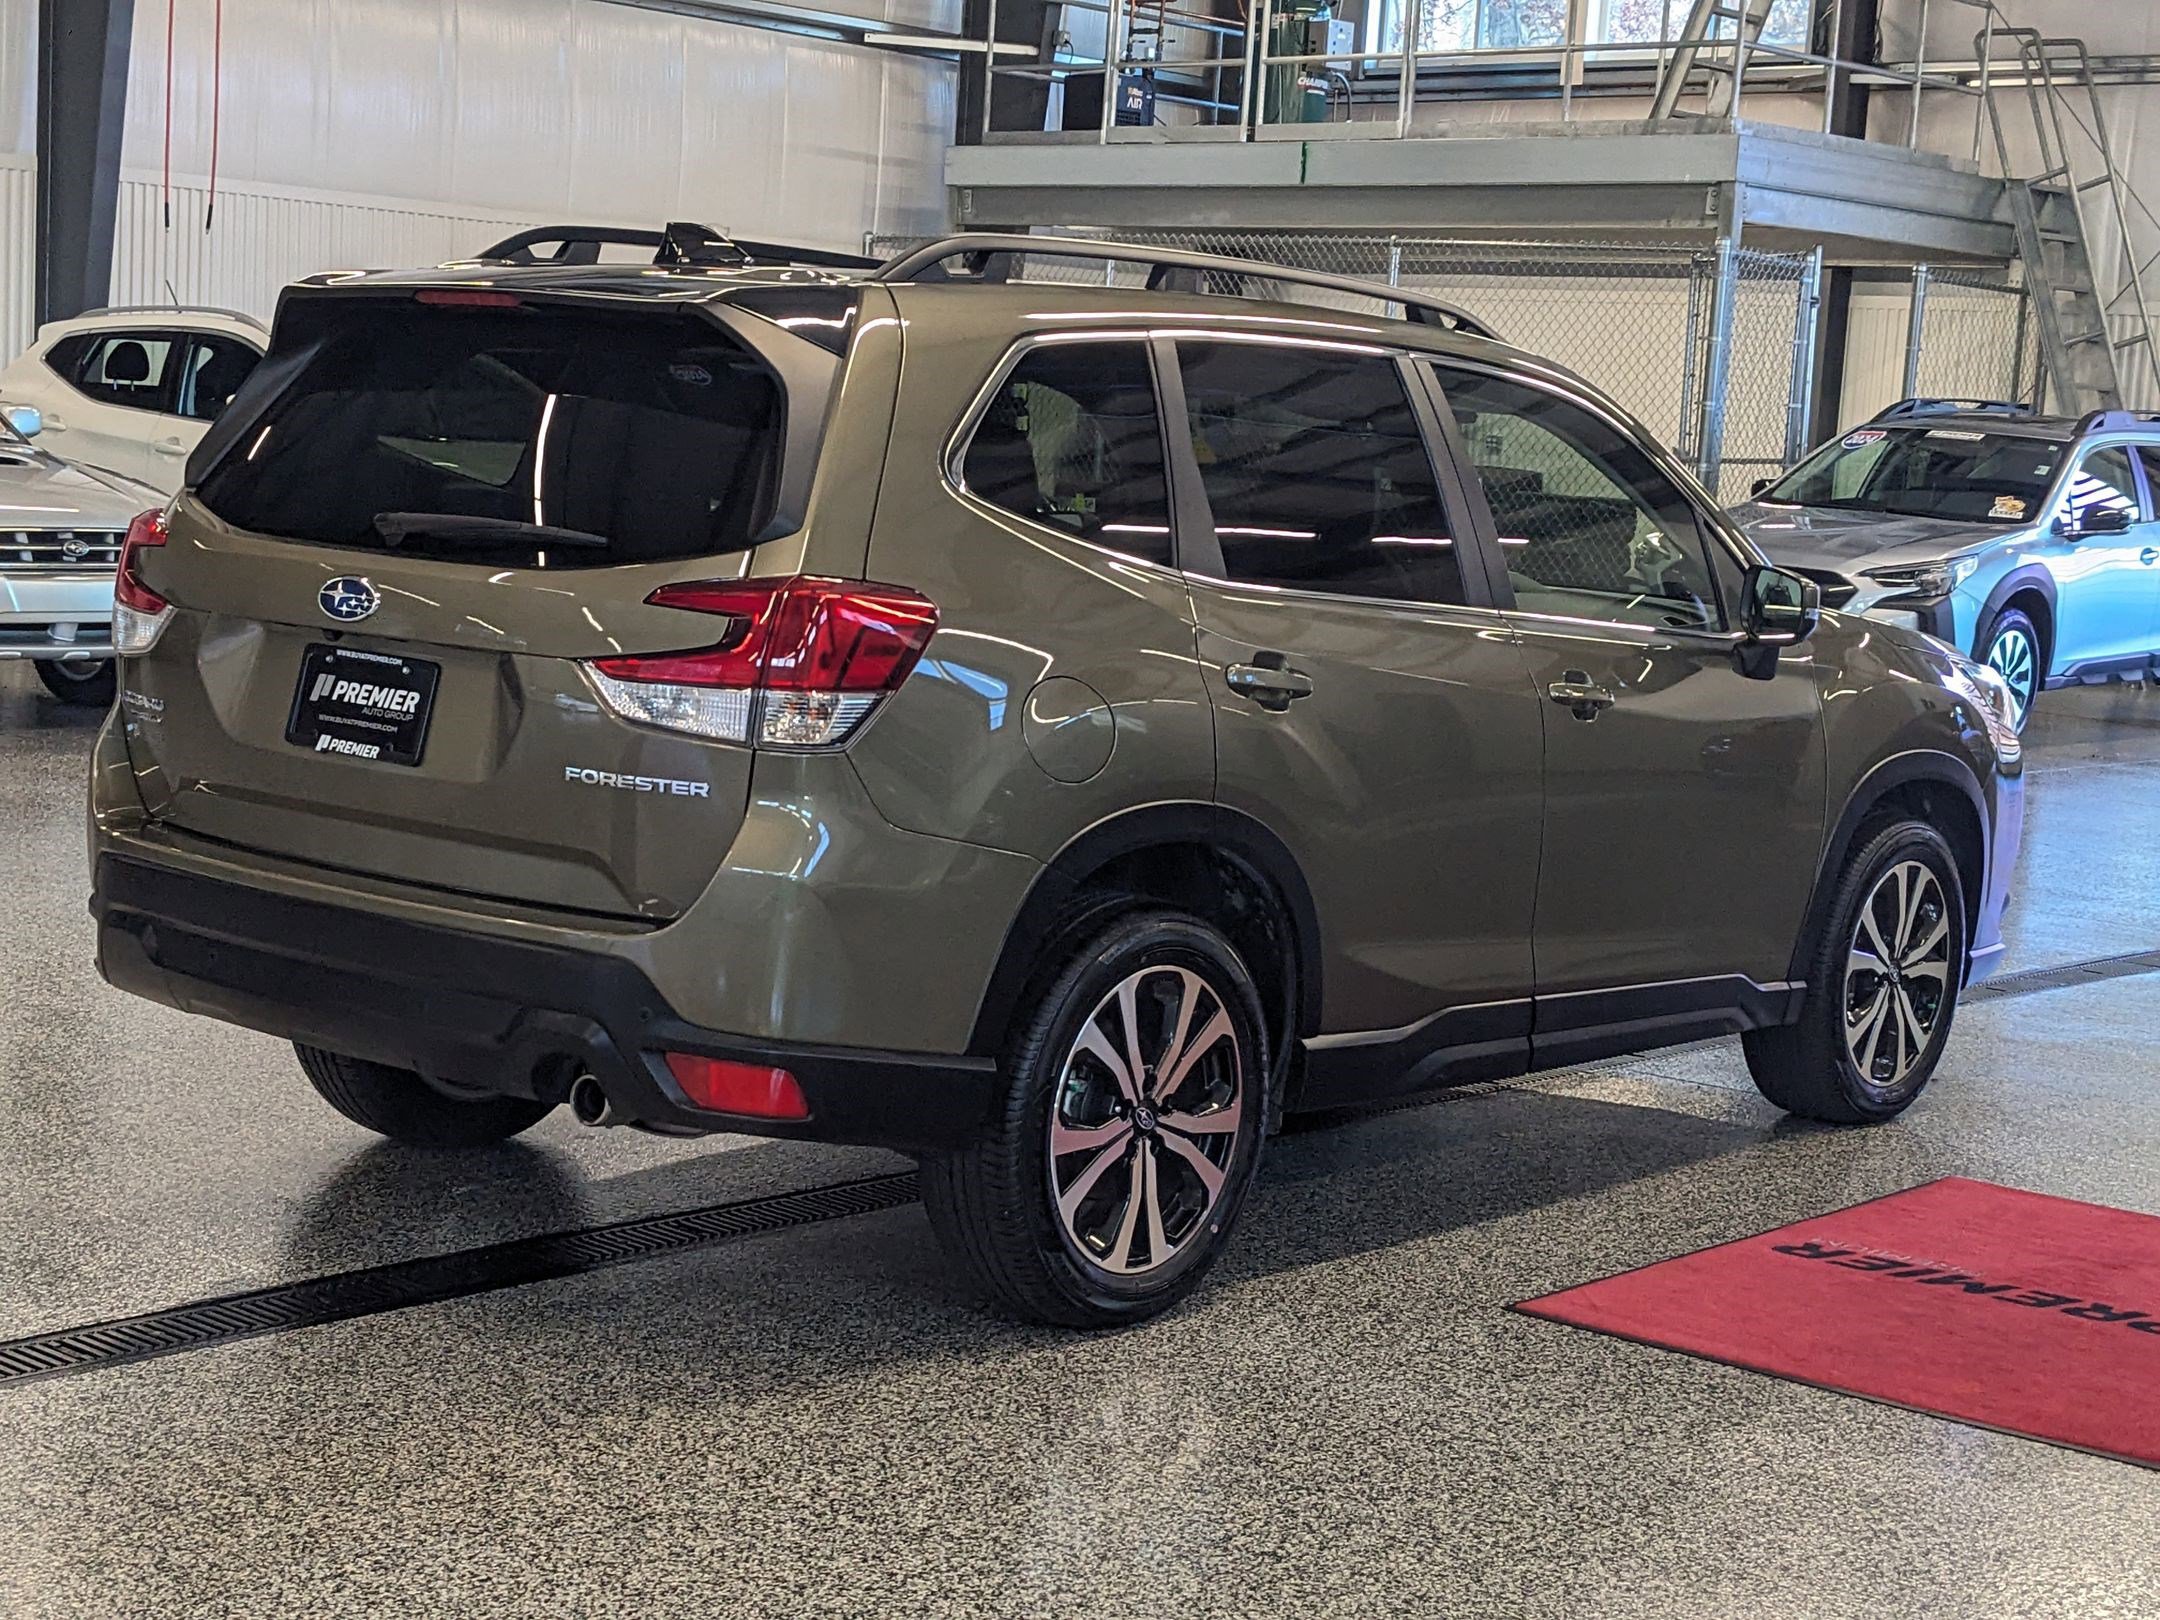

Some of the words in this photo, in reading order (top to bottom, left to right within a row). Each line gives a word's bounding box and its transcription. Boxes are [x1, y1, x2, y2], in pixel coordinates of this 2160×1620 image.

[1127, 96, 1143, 110] AIR
[332, 680, 421, 713] PREMIER
[362, 707, 383, 717] AUTO
[384, 710, 414, 721] GROUP
[328, 738, 381, 759] PREMIER
[564, 766, 711, 798] FORESTER
